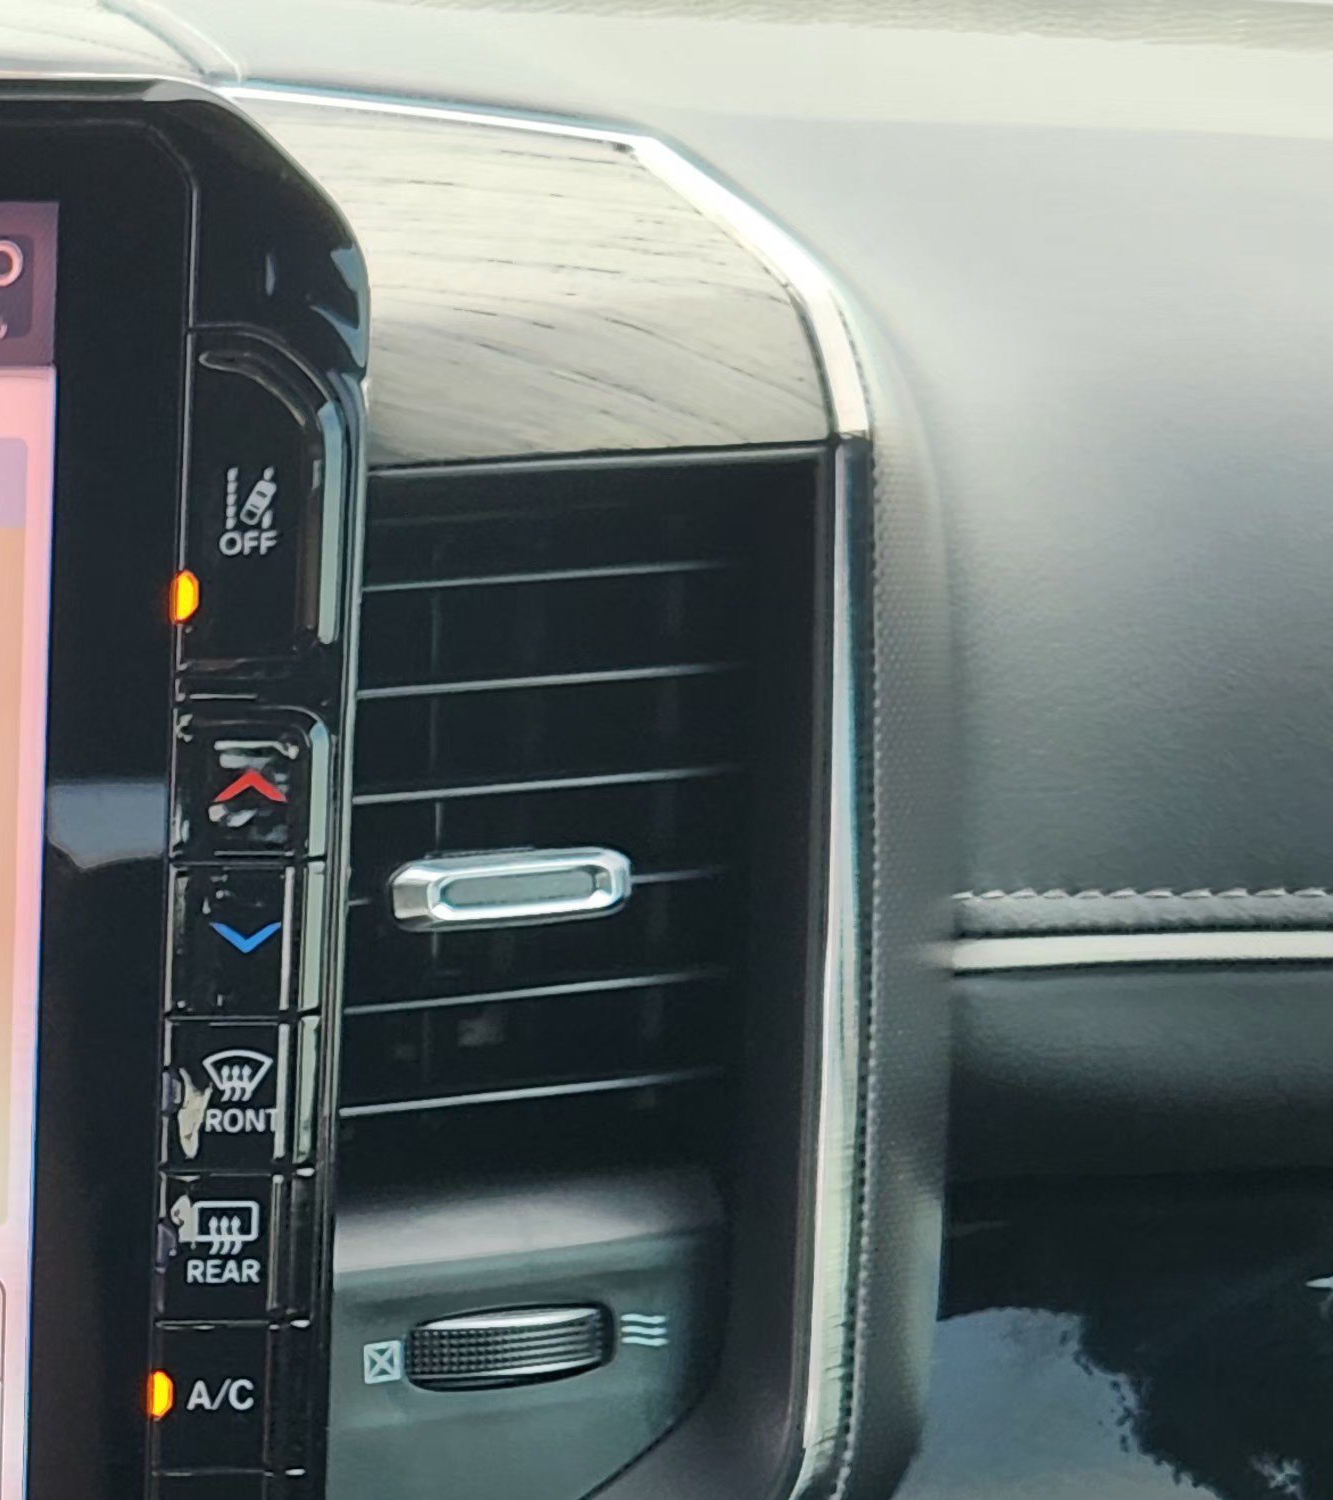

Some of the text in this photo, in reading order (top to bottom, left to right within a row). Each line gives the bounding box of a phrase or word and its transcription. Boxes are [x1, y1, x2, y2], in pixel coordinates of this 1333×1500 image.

[220, 531, 277, 555] OFF
[201, 1108, 279, 1133] RONT
[186, 1260, 261, 1284] REAR
[187, 1380, 254, 1411] A/C
